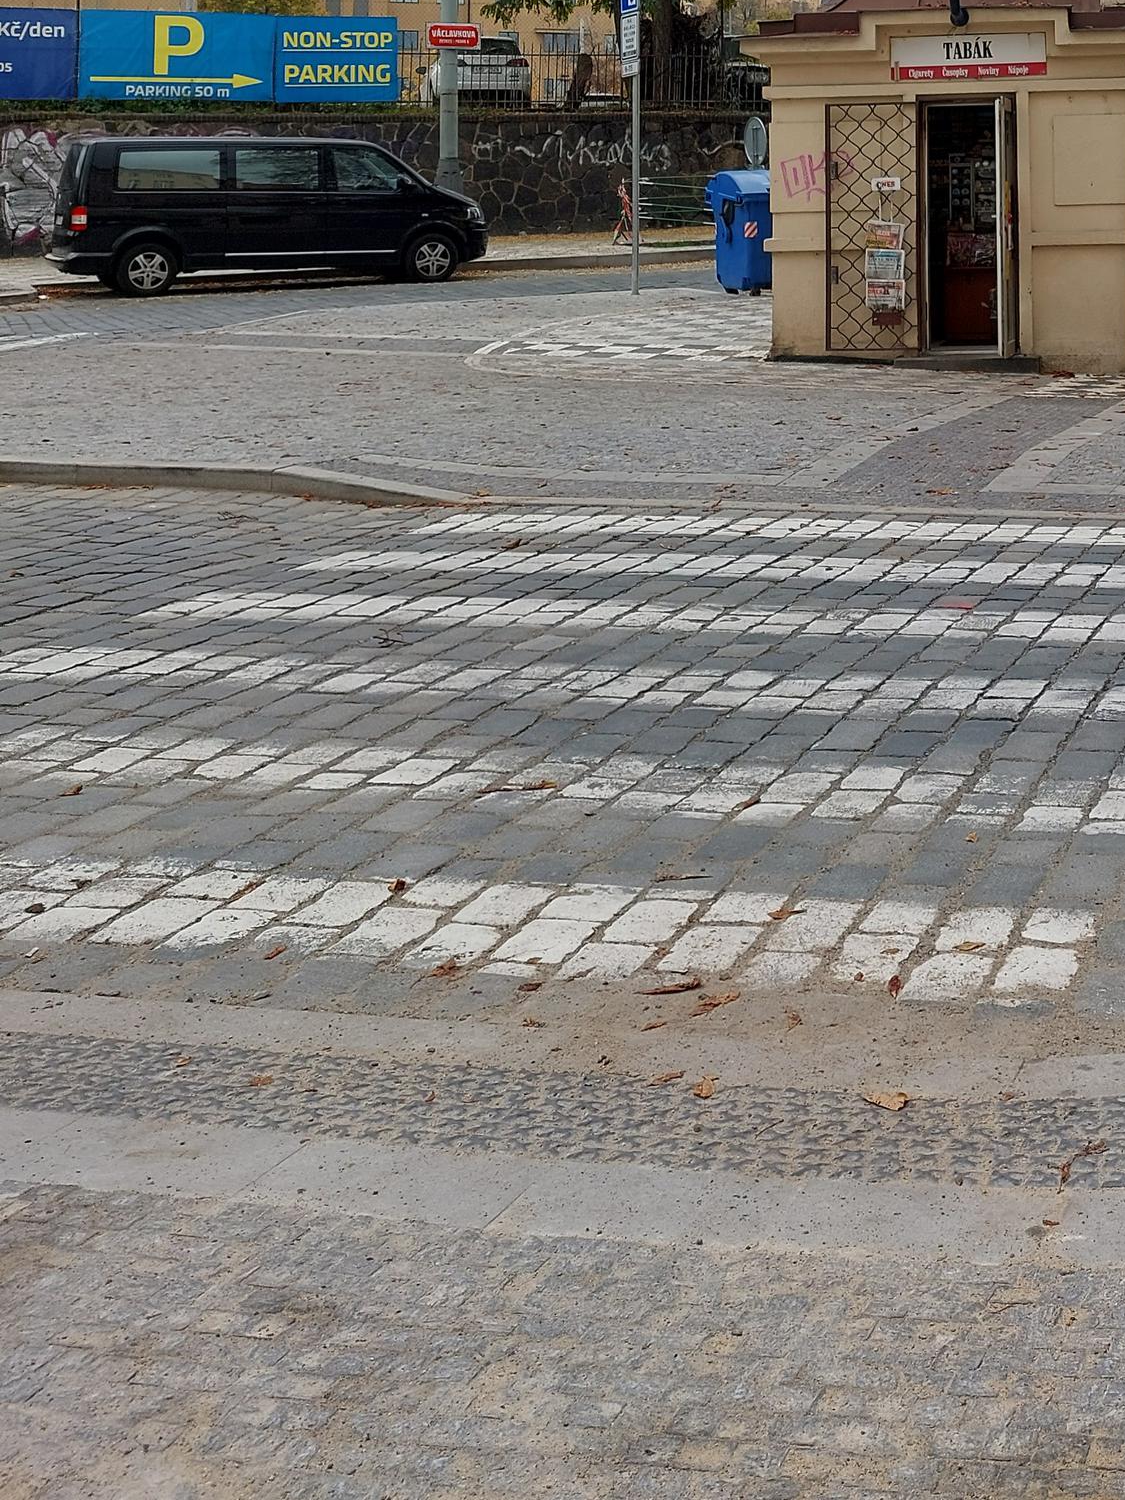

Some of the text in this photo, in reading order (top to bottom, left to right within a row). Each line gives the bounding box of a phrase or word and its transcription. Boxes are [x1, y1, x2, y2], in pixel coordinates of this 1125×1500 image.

[0, 21, 65, 41] Kč/den
[283, 31, 393, 48] NON-STOP
[431, 27, 476, 38] VÁCLAVKOVA
[153, 15, 205, 76] P
[943, 37, 993, 60] TABÁK
[284, 64, 391, 83] PARKING
[908, 65, 1029, 79] Cigarety Časopisy Noviny Nápoje
[125, 85, 230, 98] PARKING 50 m
